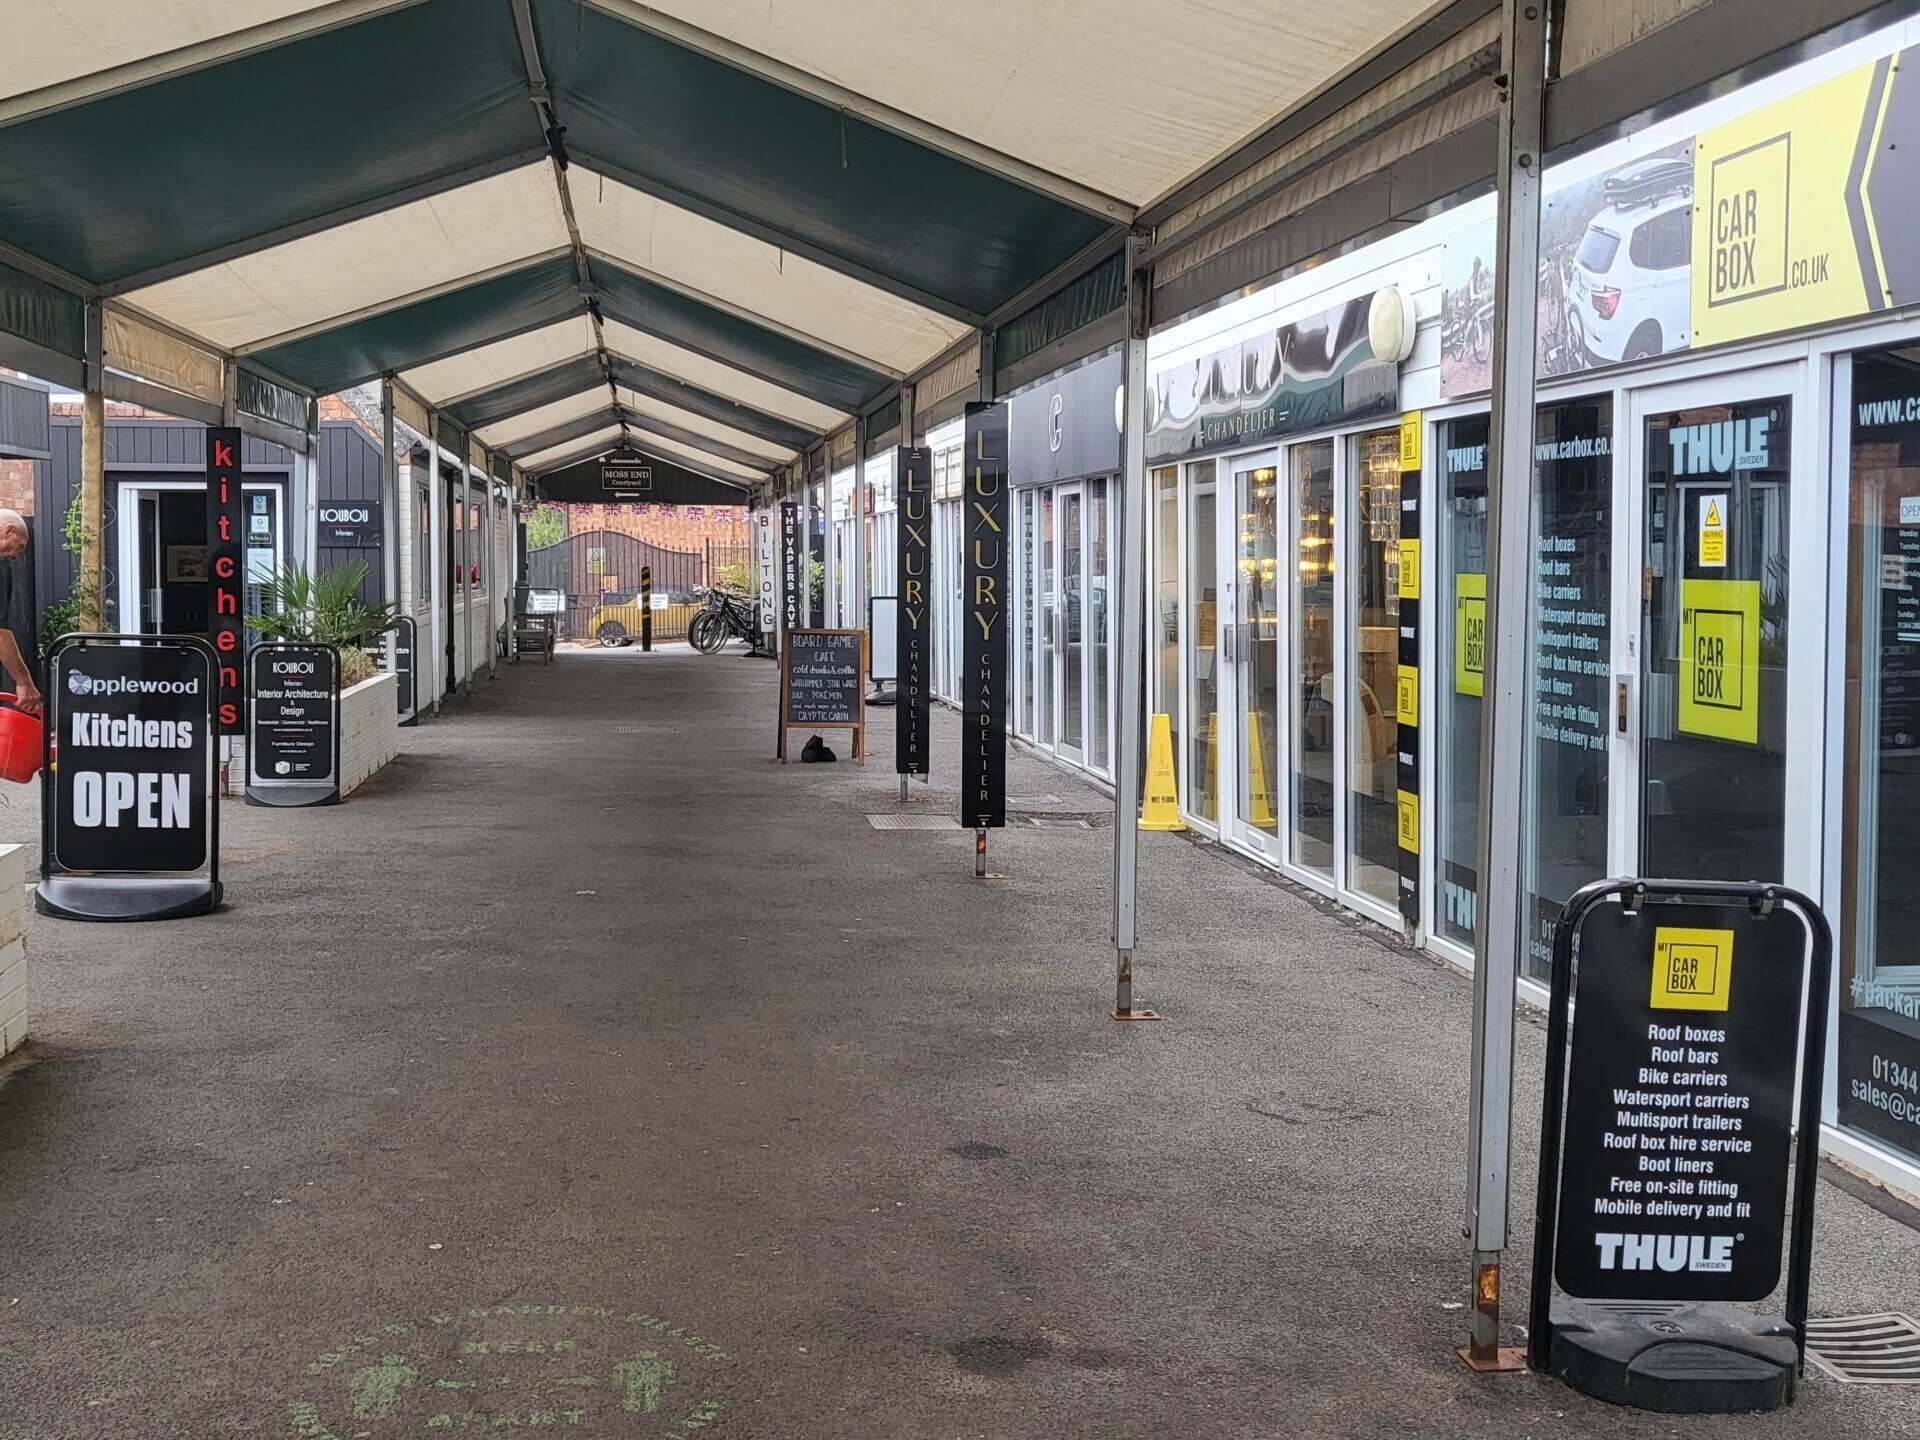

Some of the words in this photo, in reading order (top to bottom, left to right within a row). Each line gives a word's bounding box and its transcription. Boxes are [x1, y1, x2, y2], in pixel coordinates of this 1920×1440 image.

[1717, 189, 1756, 244] CAR
[1716, 238, 1755, 293] BOX
[1788, 253, 1829, 290] .CO.UK
[1207, 408, 1275, 442] CHANDELIER
[1535, 435, 1613, 461] www.carbox.co.
[1669, 416, 1769, 476] THULE
[1446, 446, 1484, 472] THULE
[1739, 455, 1764, 465] SWEDEN
[604, 470, 629, 479] MOSS
[630, 471, 649, 479] END
[611, 479, 642, 487] Courtyard
[320, 509, 369, 523] KOUBOU
[973, 430, 1002, 641] LUXURY
[1538, 536, 1553, 551] Roof
[1555, 536, 1576, 552] boxes
[905, 469, 927, 630] LUXURY
[760, 516, 773, 625] BILTONG
[786, 538, 795, 590] VAPERS
[1537, 559, 1553, 575] Roof
[1554, 561, 1571, 576] bars
[215, 440, 238, 725] kitchens
[1537, 582, 1552, 599] Bike
[1553, 585, 1581, 600] carriers
[787, 595, 796, 629] CAVE
[1458, 597, 1465, 610] MT
[1467, 618, 1483, 642] CAR
[1537, 606, 1575, 627] Watersport
[1576, 609, 1606, 627] carriers
[792, 634, 822, 648] BOARD
[827, 635, 854, 648] GAME
[1537, 629, 1571, 650] Multisport
[1573, 633, 1599, 651] trailers
[1683, 608, 1693, 625] MT
[1698, 636, 1724, 667] CAR
[1467, 643, 1483, 667] BOX
[1536, 652, 1552, 669] Roof
[1554, 653, 1566, 671] box
[1568, 656, 1582, 673] hire
[1583, 659, 1610, 677] service
[272, 662, 314, 674] KOUBOU
[793, 664, 809, 674] cold
[809, 665, 830, 674] drinks
[837, 665, 856, 674] coffee
[257, 689, 283, 699] Interior
[284, 689, 329, 699] Architecture
[827, 680, 840, 688] STAR
[842, 680, 857, 688] WARS
[1536, 675, 1552, 692] Boot
[1553, 678, 1573, 696] liners
[1697, 668, 1723, 700] BOX
[910, 640, 918, 753] CHANDELIER
[280, 706, 304, 717] Design
[797, 711, 828, 721] CRYPTIC
[828, 711, 849, 721] CABIN
[1536, 699, 1551, 716] Free
[1552, 703, 1576, 720] on-site
[1578, 705, 1599, 728] fitting
[72, 712, 193, 749] Kitchens
[980, 653, 992, 801] CHANDELIER
[1536, 722, 1558, 741] Mobile
[1560, 726, 1588, 751] delivery
[1590, 734, 1604, 751] and
[73, 770, 191, 829] OPEN
[1530, 940, 1554, 962] sales
[1657, 942, 1668, 952] MT
[1672, 957, 1698, 974] CAR
[1671, 974, 1697, 990] BOX
[1648, 1024, 1681, 1041] Roof
[1685, 1026, 1726, 1043] boxes
[1651, 1046, 1684, 1063] Roof
[1688, 1048, 1719, 1064] bars
[1639, 1068, 1668, 1084] Bike
[1673, 1070, 1728, 1086] carriers
[1872, 1055, 1918, 1094] 01344
[1613, 1089, 1691, 1110] Watersport
[1695, 1093, 1750, 1109] carriers
[1617, 1111, 1688, 1131] Multisport
[1692, 1114, 1742, 1131] trailers
[1604, 1132, 1637, 1149] Roof
[1641, 1134, 1666, 1150] box
[1670, 1135, 1697, 1151] hire
[1701, 1137, 1752, 1153] service
[1639, 1156, 1671, 1172] Boot
[1675, 1157, 1714, 1173] liners
[1610, 1176, 1642, 1193] Free
[1646, 1179, 1694, 1195] on-site
[1698, 1180, 1738, 1199] fitting
[1595, 1198, 1642, 1215] Mobile
[1646, 1200, 1703, 1220] delivery
[1707, 1202, 1732, 1217] and
[1737, 1203, 1751, 1218] fit
[1595, 1232, 1735, 1273] THULE
[1694, 1261, 1727, 1269] SWEDEN
